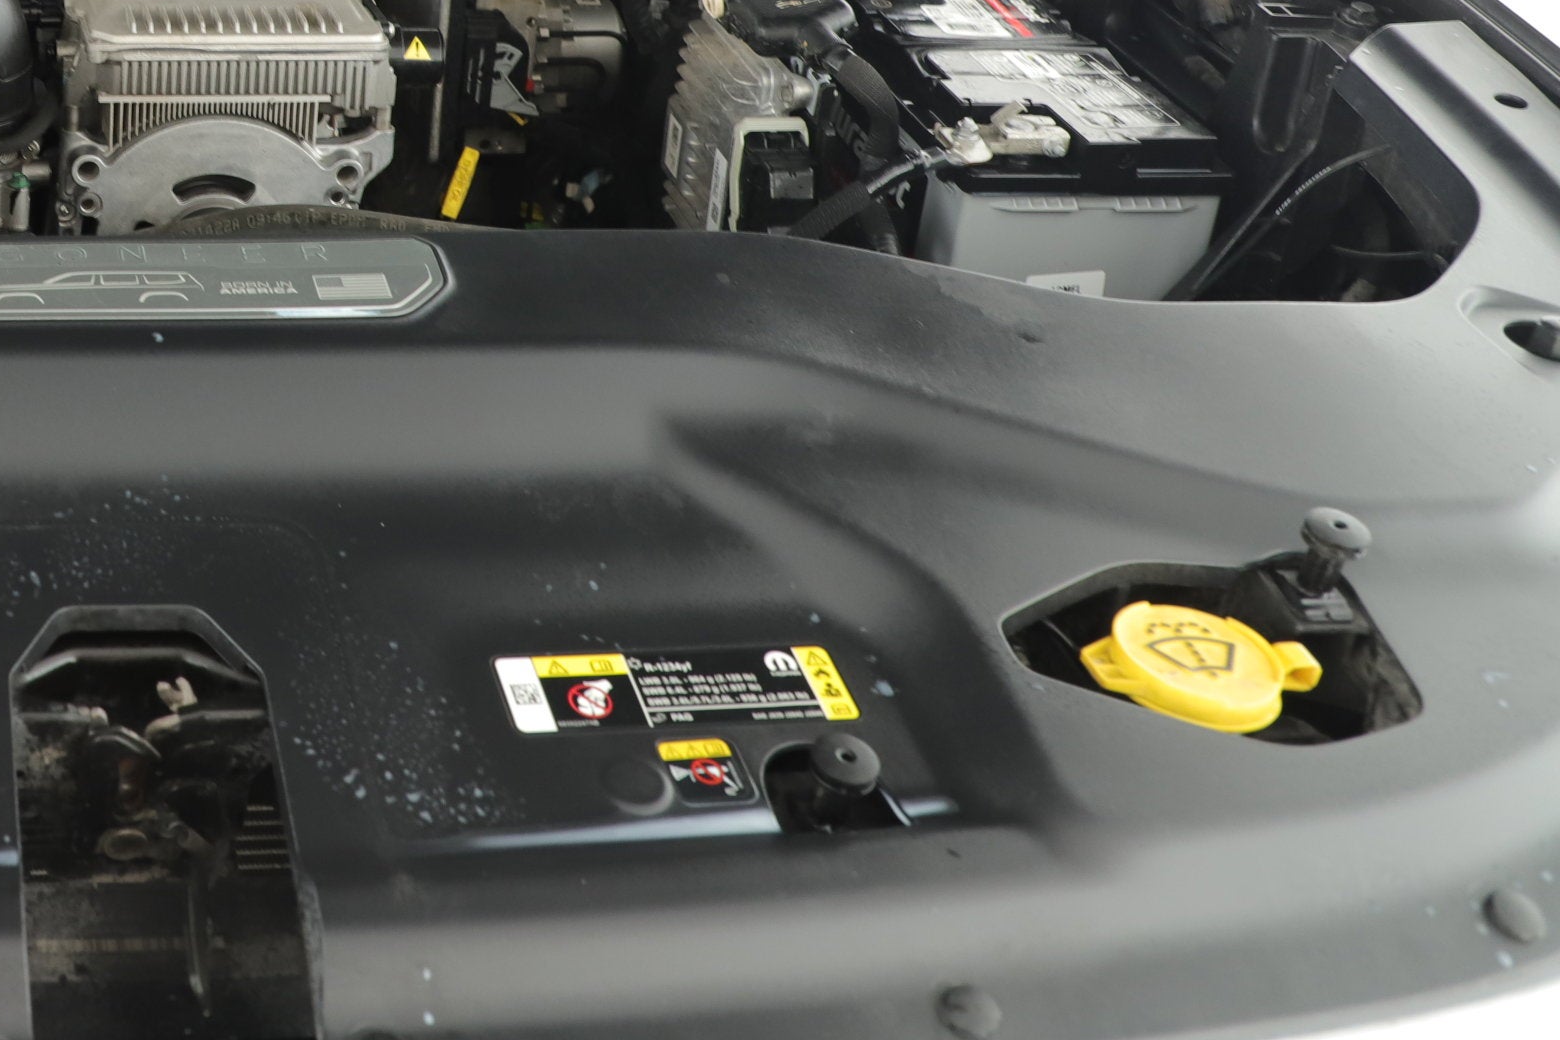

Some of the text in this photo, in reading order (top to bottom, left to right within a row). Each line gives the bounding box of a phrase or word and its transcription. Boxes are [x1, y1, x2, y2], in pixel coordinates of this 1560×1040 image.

[220, 281, 271, 289] BORN
[219, 287, 298, 295] AMERICA
[643, 661, 692, 673] R-1234yf
